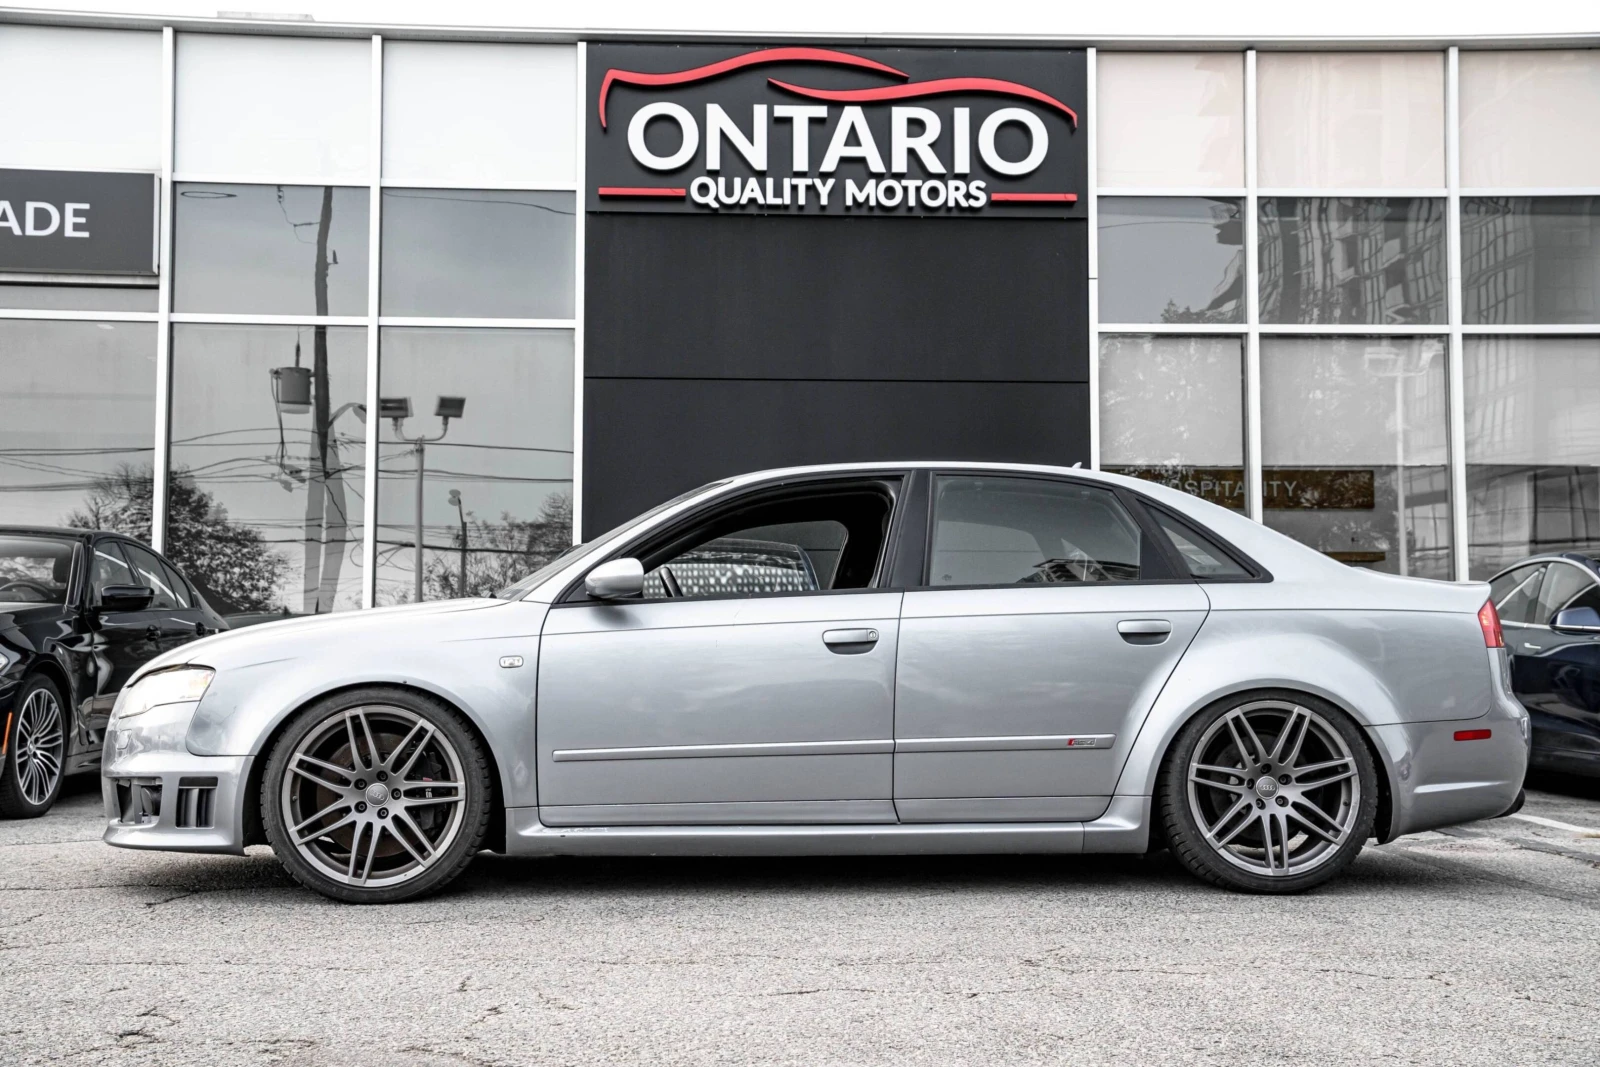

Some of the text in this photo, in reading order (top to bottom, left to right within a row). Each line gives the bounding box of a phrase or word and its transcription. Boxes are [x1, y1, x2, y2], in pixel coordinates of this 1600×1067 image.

[628, 101, 1049, 175] ONTARIO
[690, 176, 987, 208] QUALITY MOTORS
